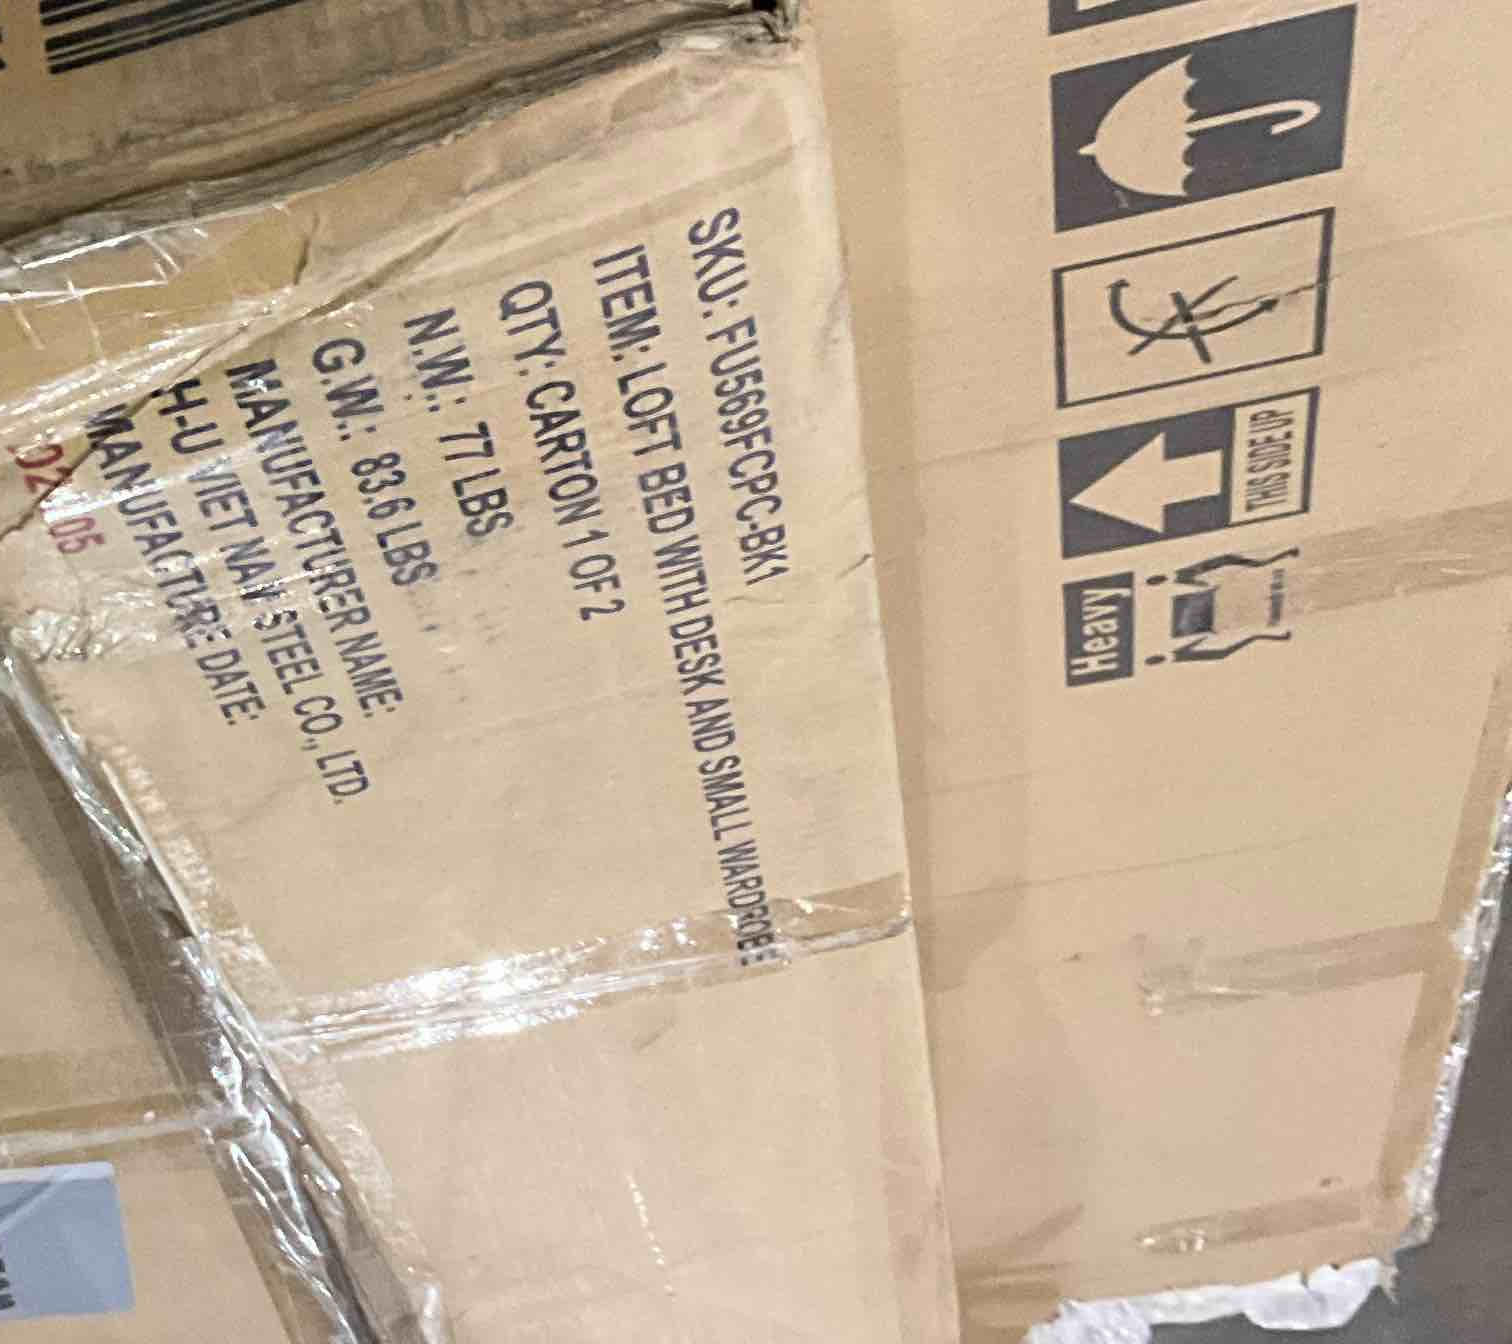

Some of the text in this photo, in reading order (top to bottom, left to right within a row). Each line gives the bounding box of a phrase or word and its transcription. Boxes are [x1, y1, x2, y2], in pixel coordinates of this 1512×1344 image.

[592, 243, 662, 363] ITEM:
[617, 361, 683, 458] LOFT
[686, 206, 791, 587] SKU: FU569FCPC-BK1
[1248, 408, 1295, 434] UP
[437, 420, 496, 463] 77
[498, 279, 626, 623] QTY: CARTON 1 OF 2
[1246, 432, 1294, 475] SIDE
[350, 451, 417, 521] 83.6
[451, 467, 515, 539] LBS
[637, 461, 696, 535] BED
[1245, 471, 1292, 513] THIS
[224, 357, 405, 719] MANUFACTURER NAME:
[375, 520, 439, 588] LBS
[653, 534, 711, 616] WITH
[668, 613, 727, 696] DESK
[1070, 587, 1132, 677] Heavy
[195, 647, 267, 726] DATE:
[252, 607, 325, 697] STEEL
[314, 749, 370, 806] LTD.
[684, 697, 737, 754] AND
[697, 754, 754, 843] SMALL
